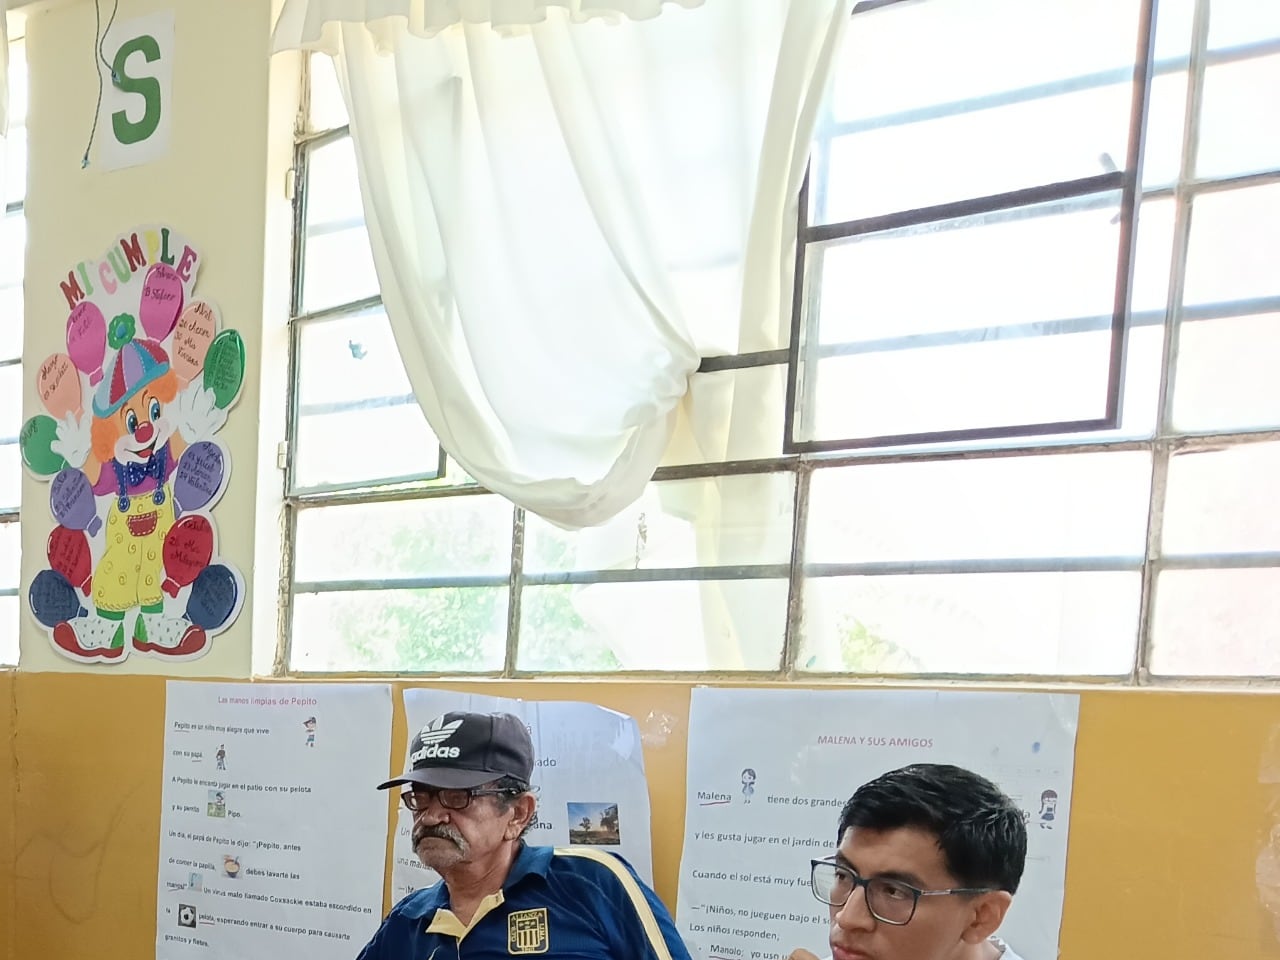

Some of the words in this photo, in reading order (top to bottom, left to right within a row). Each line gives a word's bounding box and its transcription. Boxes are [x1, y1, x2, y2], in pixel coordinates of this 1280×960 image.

[111, 35, 161, 144] S
[60, 262, 94, 310] MI
[98, 228, 197, 294] CUMPLE
[279, 697, 289, 705] de
[291, 697, 317, 706] Pepito
[243, 727, 255, 735] que
[817, 735, 857, 745] MALENA
[859, 736, 865, 745] Y
[867, 737, 887, 746] SUS
[888, 737, 934, 748] AMIGOS
[410, 743, 461, 764] adidas
[246, 784, 263, 792] patio
[289, 785, 312, 794] pelota
[697, 791, 732, 801] Malena
[767, 795, 790, 804] tiene
[792, 796, 809, 805] dos
[701, 831, 715, 840] les
[717, 832, 742, 842] gusta
[743, 832, 766, 845] jugar
[768, 836, 780, 844] en
[781, 836, 790, 845] el
[822, 839, 835, 848] de
[283, 843, 301, 851] antes
[245, 868, 265, 877] debes
[266, 870, 289, 879] lavarte
[290, 872, 300, 880] las
[692, 869, 727, 880] Cuando
[729, 872, 738, 881] el
[739, 871, 752, 882] sol
[753, 873, 772, 884] está
[773, 876, 795, 887] muy
[796, 877, 813, 887] fue
[227, 891, 243, 899] malo
[244, 892, 269, 902] llamado
[304, 900, 328, 908] estaba
[328, 902, 362, 913] escondido
[738, 908, 749, 917] no
[750, 909, 787, 921] jueguen
[788, 912, 810, 924] bajo
[811, 914, 821, 924] el
[216, 917, 249, 927] esperando
[249, 921, 268, 930] entrar
[275, 924, 283, 932] su
[283, 926, 307, 936] cuerpo
[308, 928, 323, 937] para
[323, 930, 351, 941] causarte
[689, 922, 705, 933] Los
[706, 923, 731, 935] niños
[732, 928, 780, 941] responden,
[750, 950, 762, 960] yo
[763, 951, 780, 960] uso
